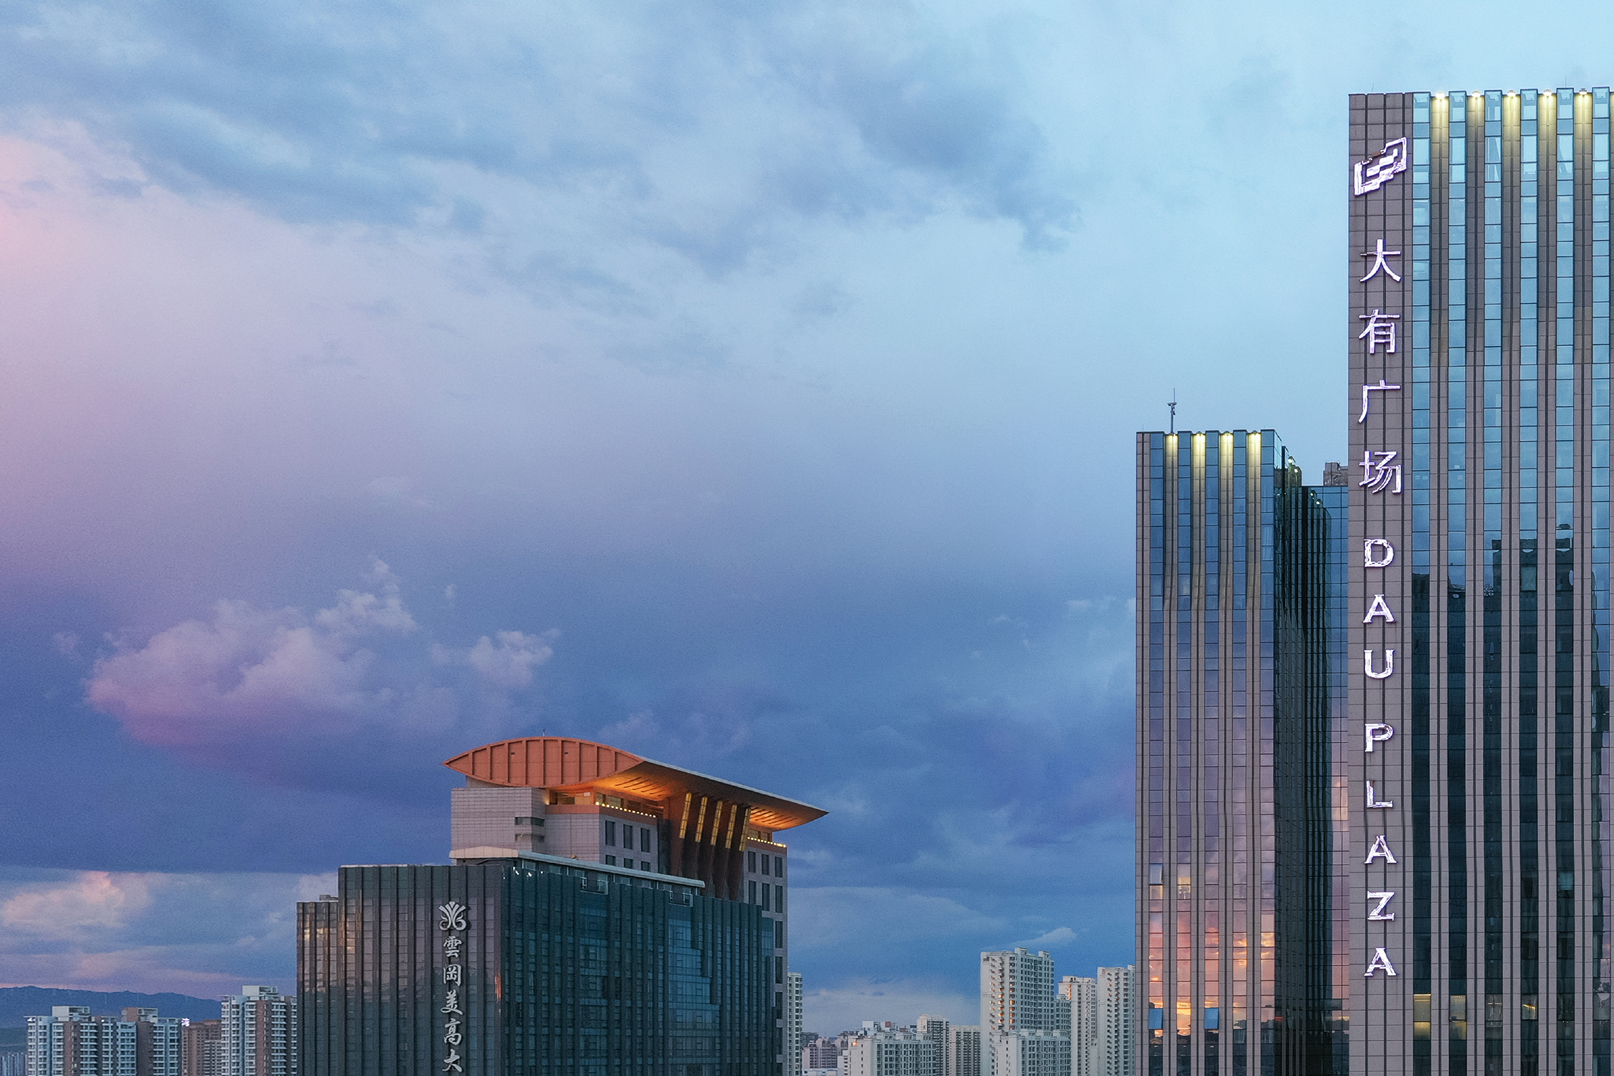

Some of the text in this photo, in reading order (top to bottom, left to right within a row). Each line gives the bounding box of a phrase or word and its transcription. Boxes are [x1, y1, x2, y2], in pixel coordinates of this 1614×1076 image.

[1359, 239, 1402, 494] 大有广场
[1363, 538, 1397, 977] DAU PLAZA
